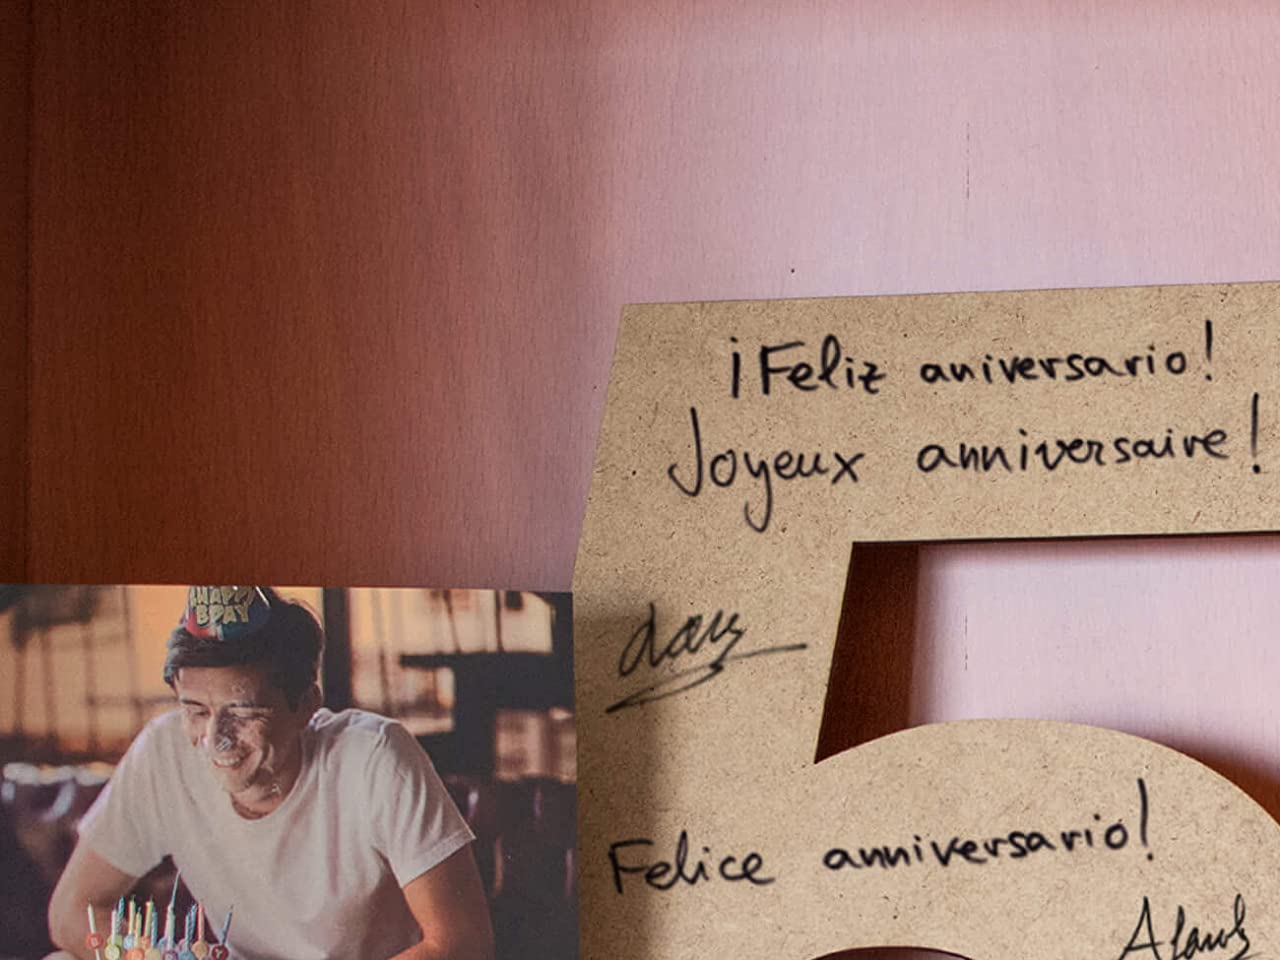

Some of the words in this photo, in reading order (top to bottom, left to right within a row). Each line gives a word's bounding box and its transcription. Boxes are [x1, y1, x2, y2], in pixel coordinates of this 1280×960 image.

[666, 406, 866, 534] Joyeux
[608, 829, 777, 895] Felice
[822, 777, 1156, 874] anniversario!
